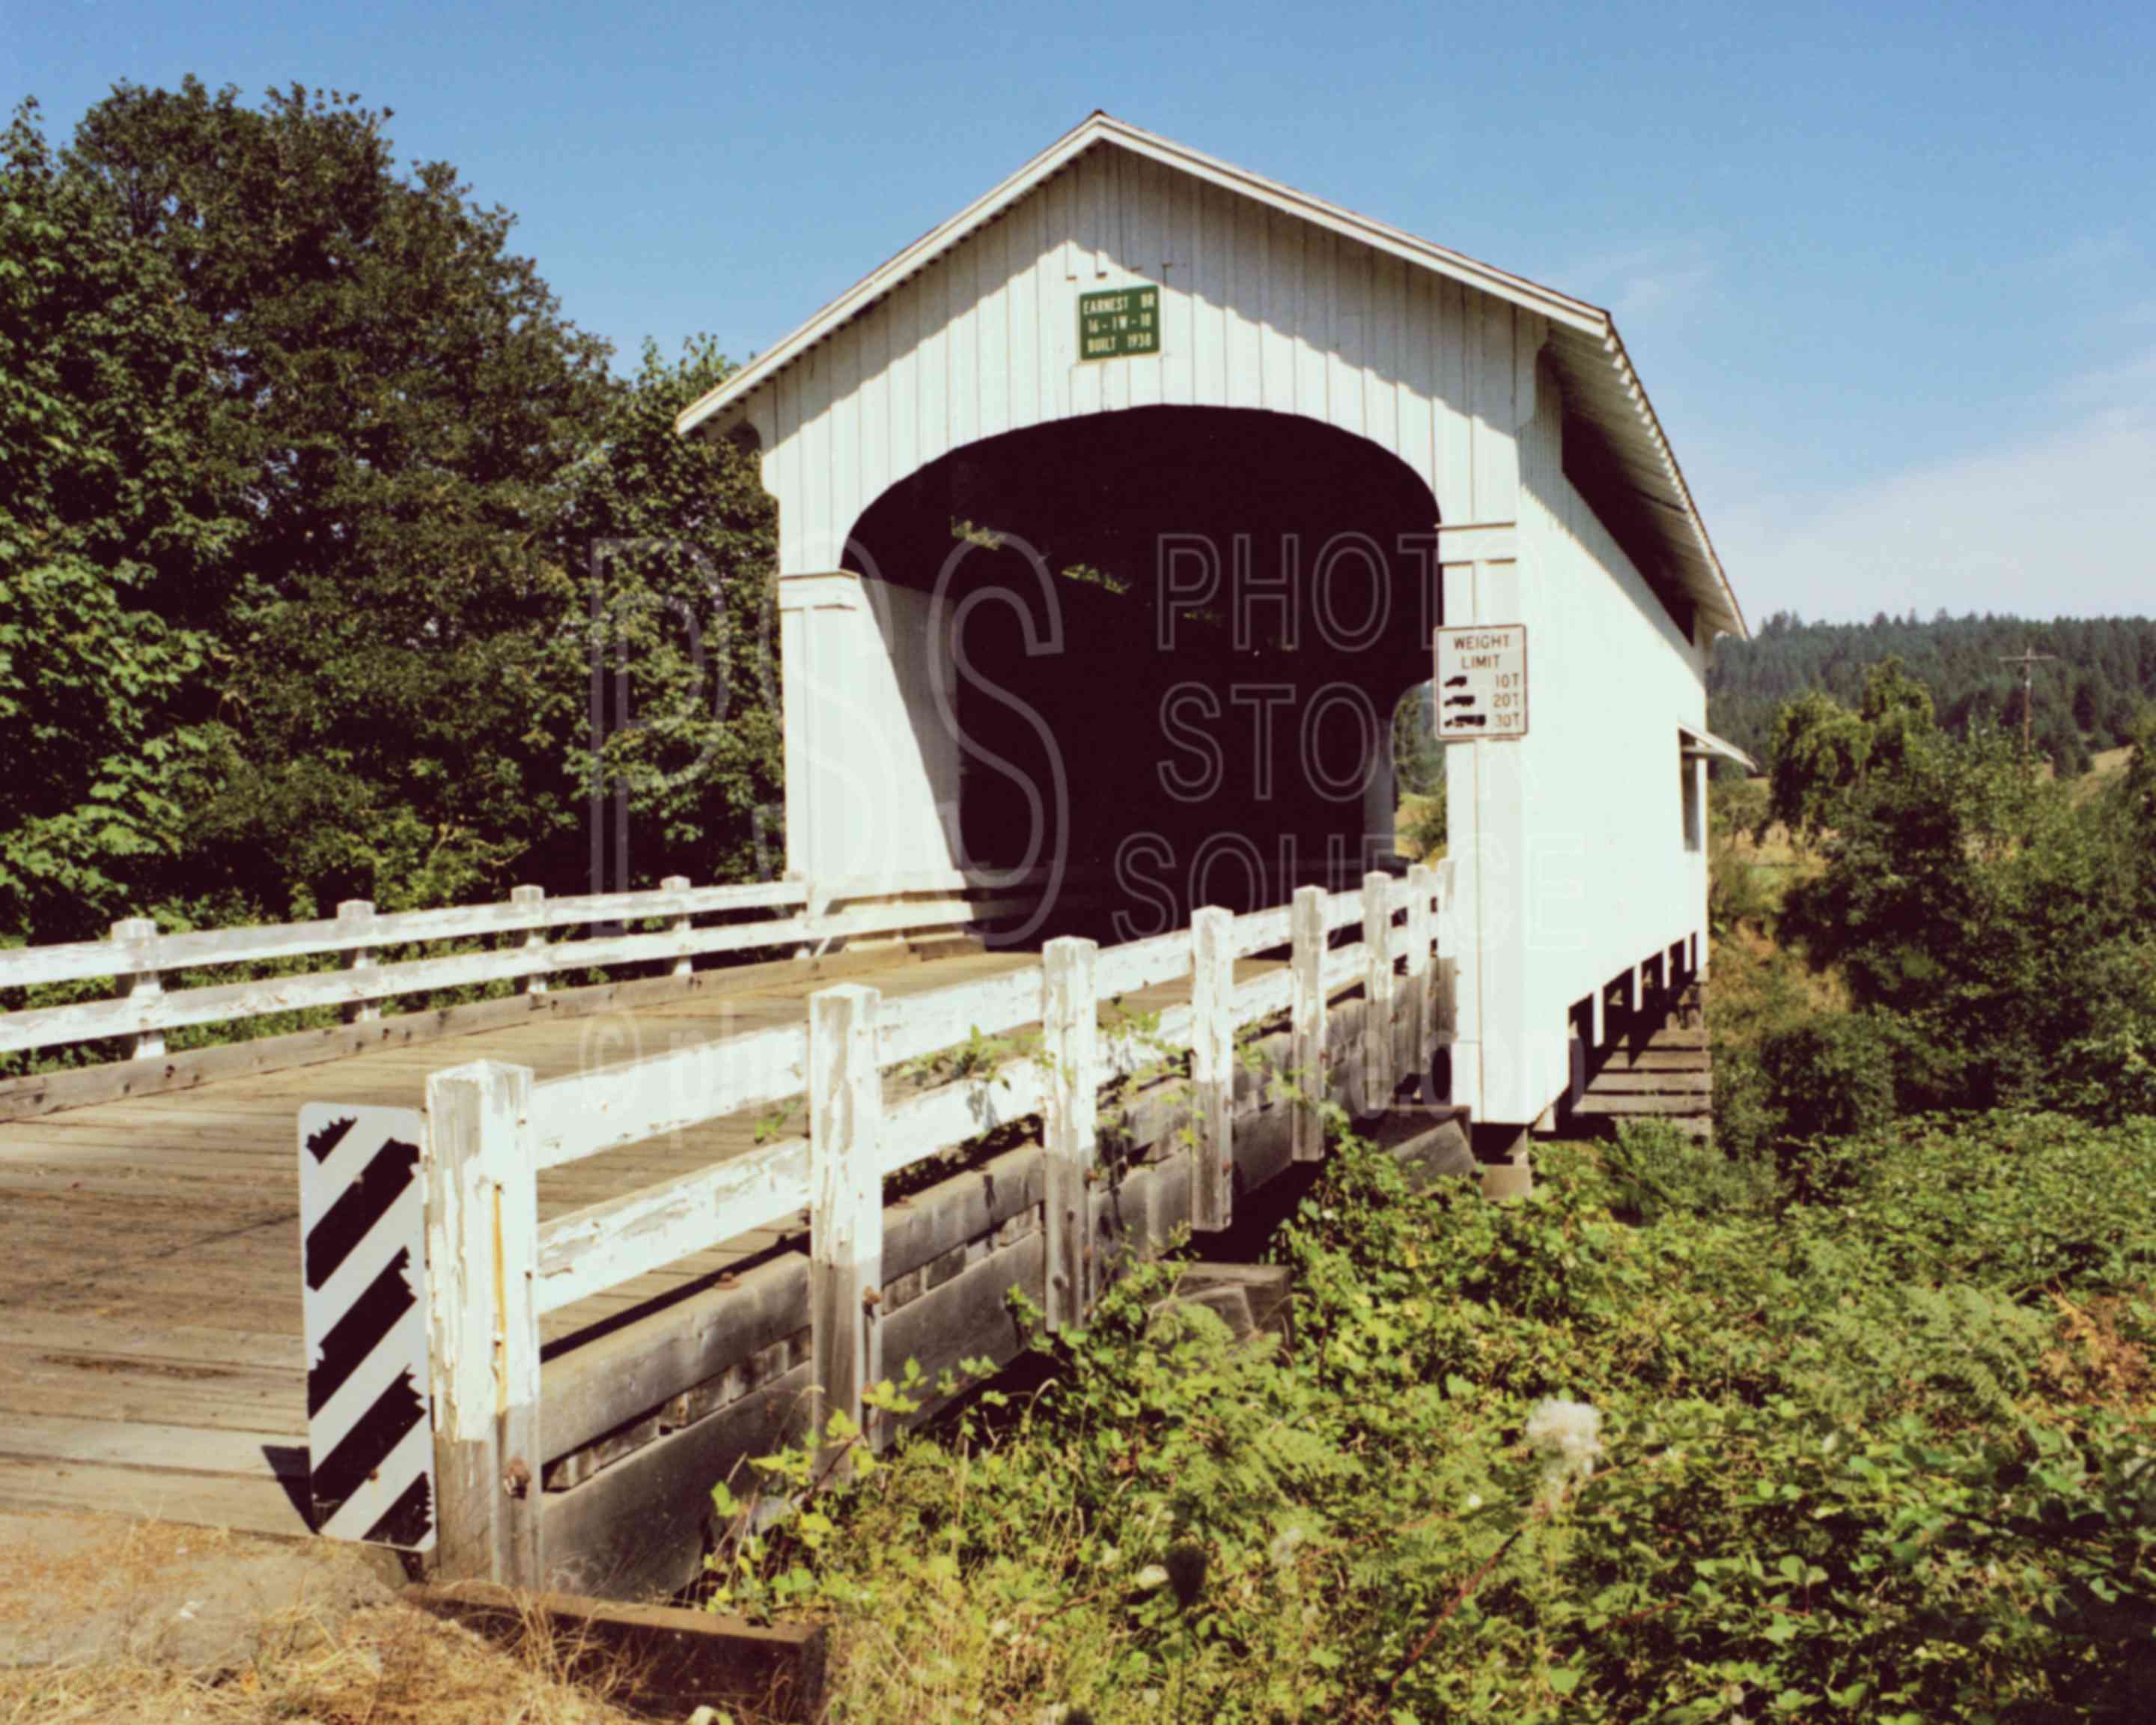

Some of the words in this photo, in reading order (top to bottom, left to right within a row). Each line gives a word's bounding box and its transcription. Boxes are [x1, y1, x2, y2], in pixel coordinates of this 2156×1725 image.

[1083, 295, 1128, 314] EARNEST
[1454, 634, 1510, 650] WEIGHT
[1461, 654, 1500, 670] LIMIT
[1496, 672, 1519, 688] 10T
[1493, 693, 1519, 708] 20T
